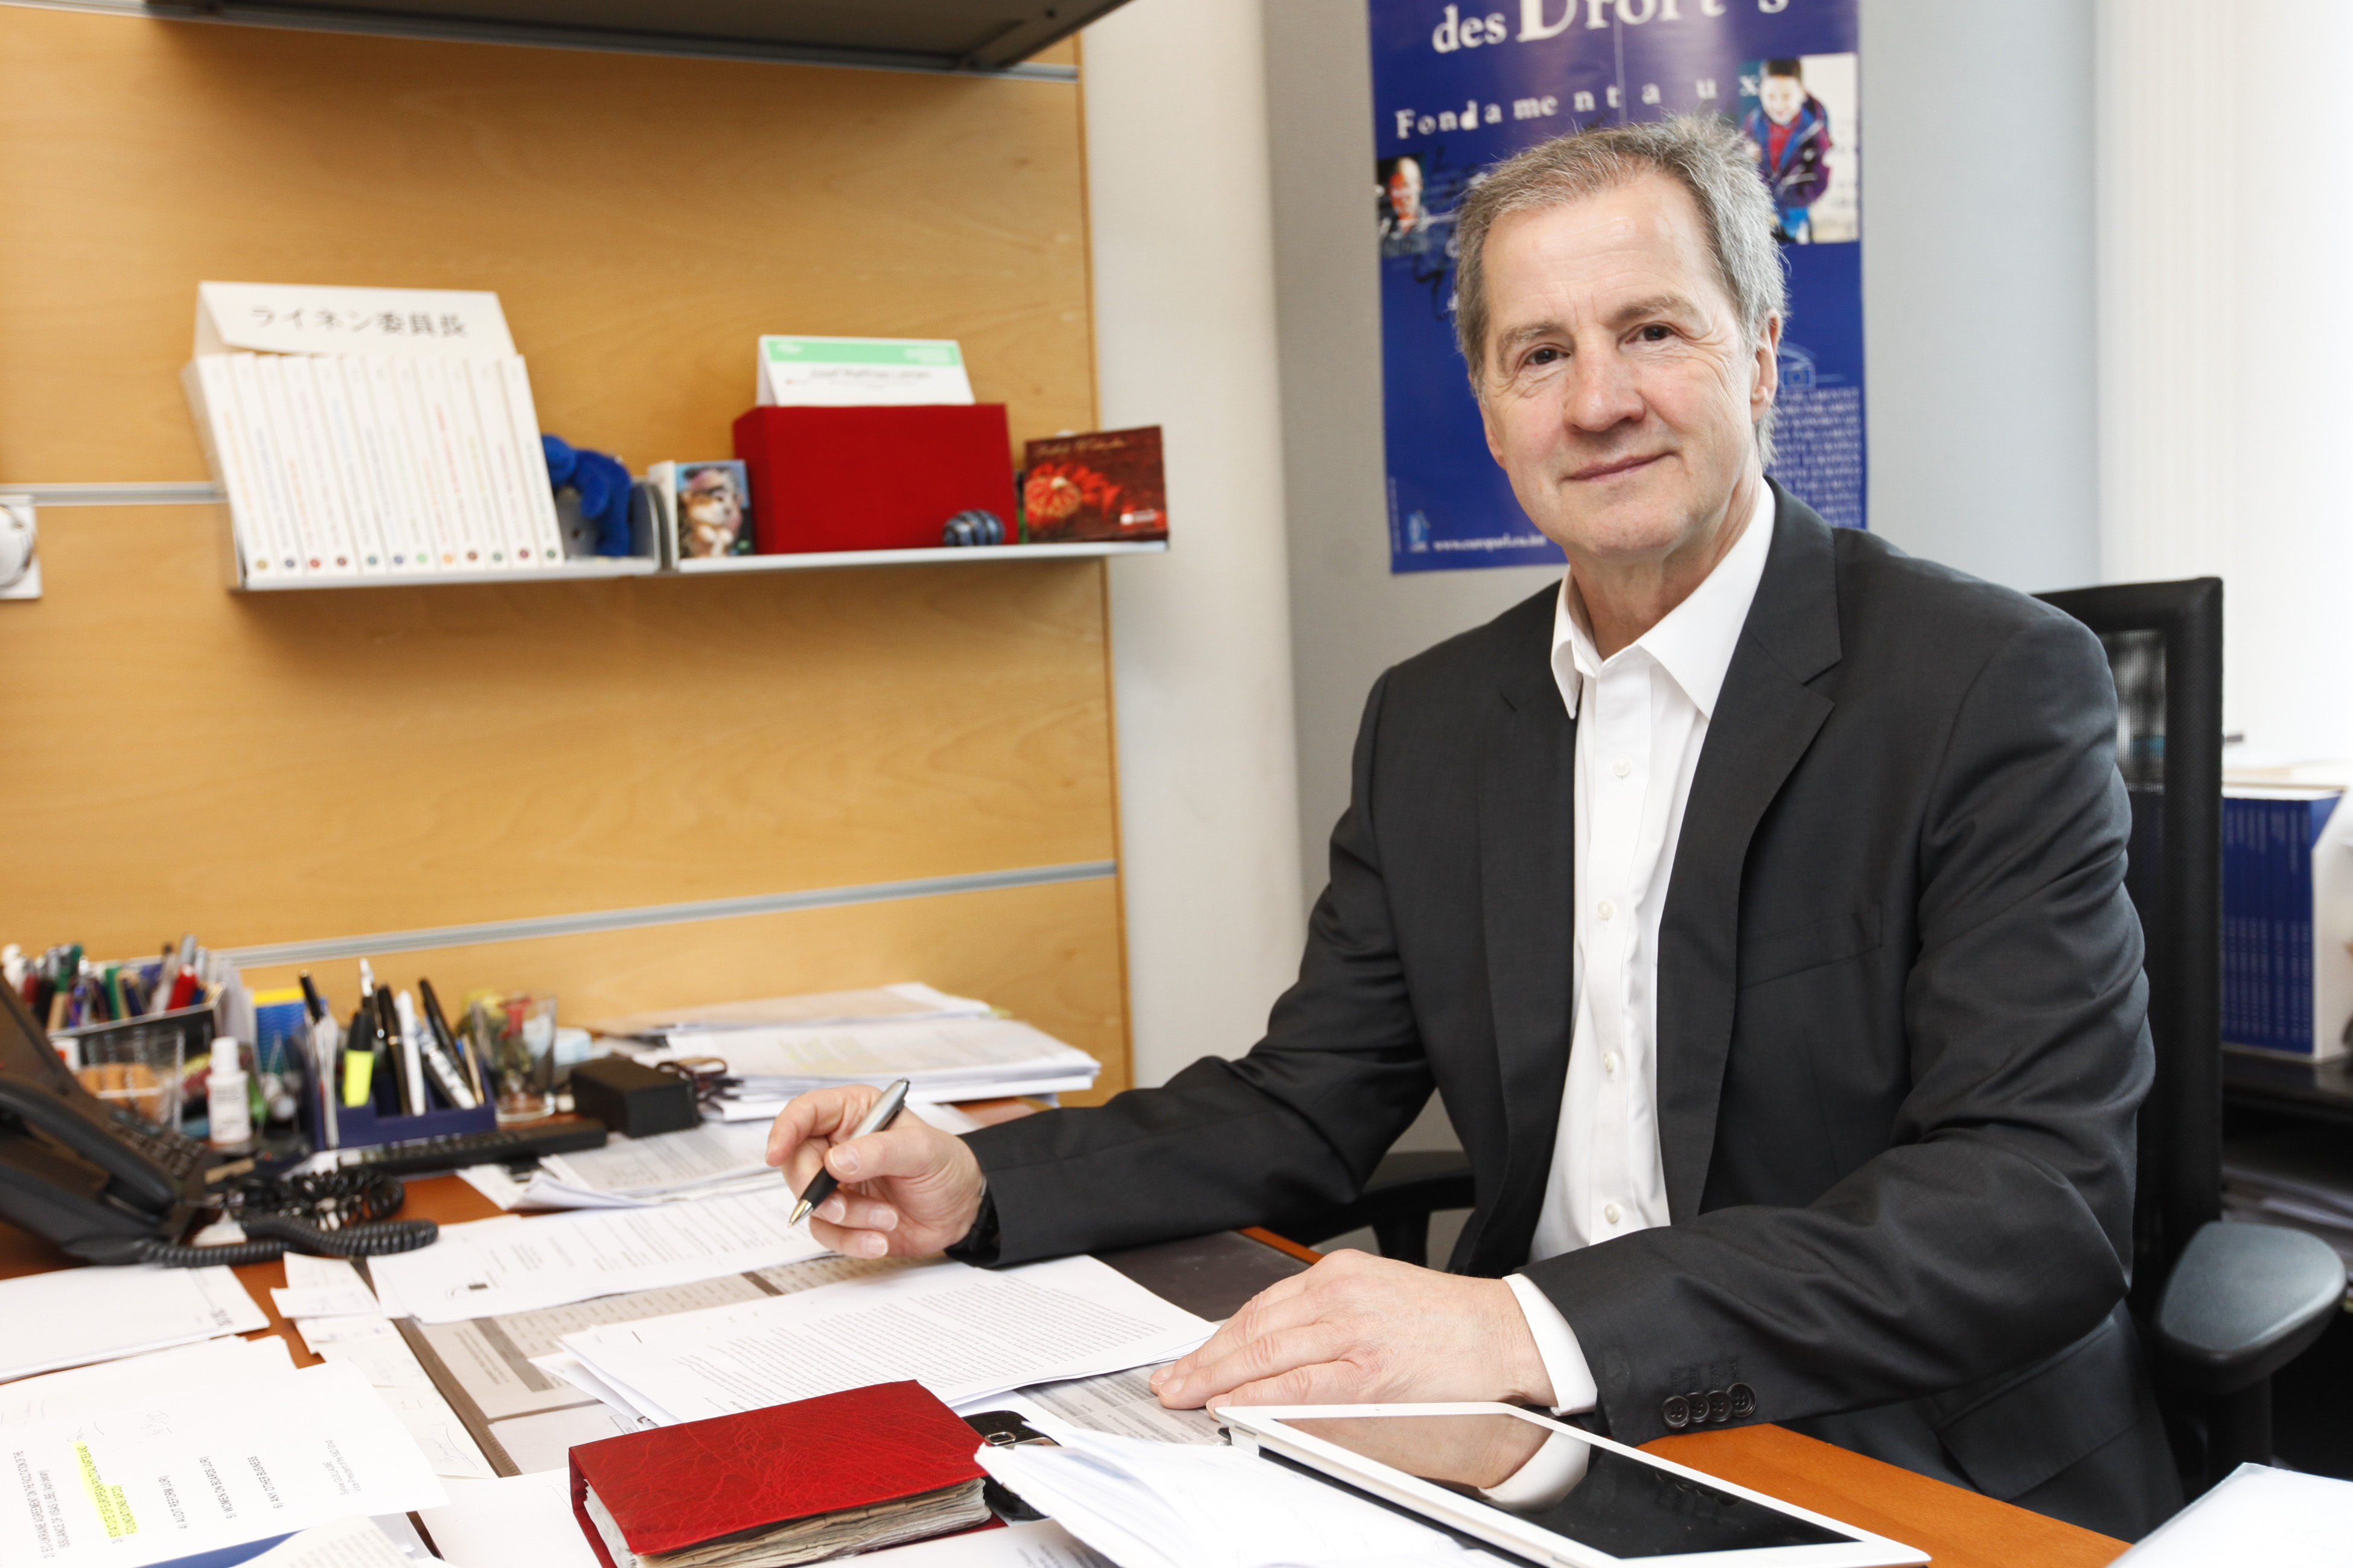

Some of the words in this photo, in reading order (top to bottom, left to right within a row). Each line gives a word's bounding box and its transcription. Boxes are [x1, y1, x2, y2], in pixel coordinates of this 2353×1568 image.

[1432, 2, 1507, 54] des
[247, 1456, 266, 1475] BUSINESS
[204, 1468, 221, 1485] BOARDS
[258, 1476, 275, 1491] OTHER
[92, 1484, 110, 1507] EUROPEAN
[162, 1488, 180, 1506] REFORM
[216, 1493, 234, 1512] WOMEN
[267, 1491, 279, 1502] ANY
[115, 1500, 138, 1534] FOUNDATIONS
[171, 1507, 187, 1522] AUDIT
[103, 1515, 122, 1537] STATUTE
